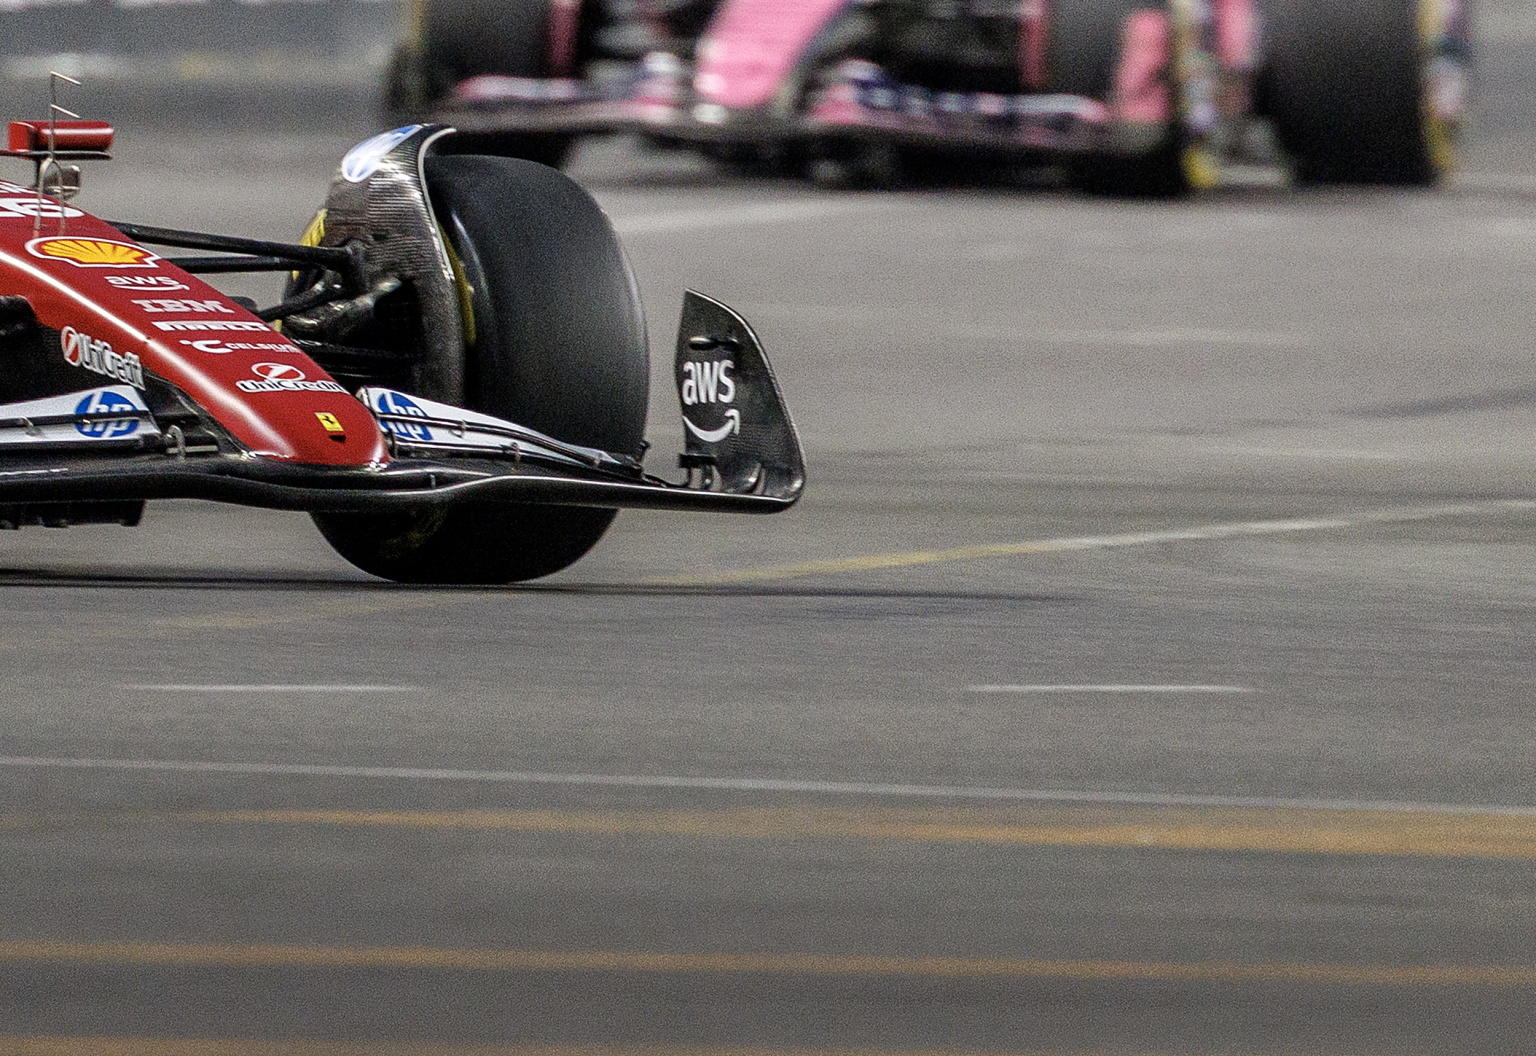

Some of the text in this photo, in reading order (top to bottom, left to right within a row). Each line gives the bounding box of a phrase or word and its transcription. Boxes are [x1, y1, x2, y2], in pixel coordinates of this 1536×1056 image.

[104, 276, 181, 286] aws
[131, 299, 235, 313] IBM
[151, 320, 271, 332] PIRELLI
[235, 380, 351, 395] UniCredit
[682, 360, 735, 405] aws
[80, 392, 134, 438] hp
[382, 392, 427, 440] hp
